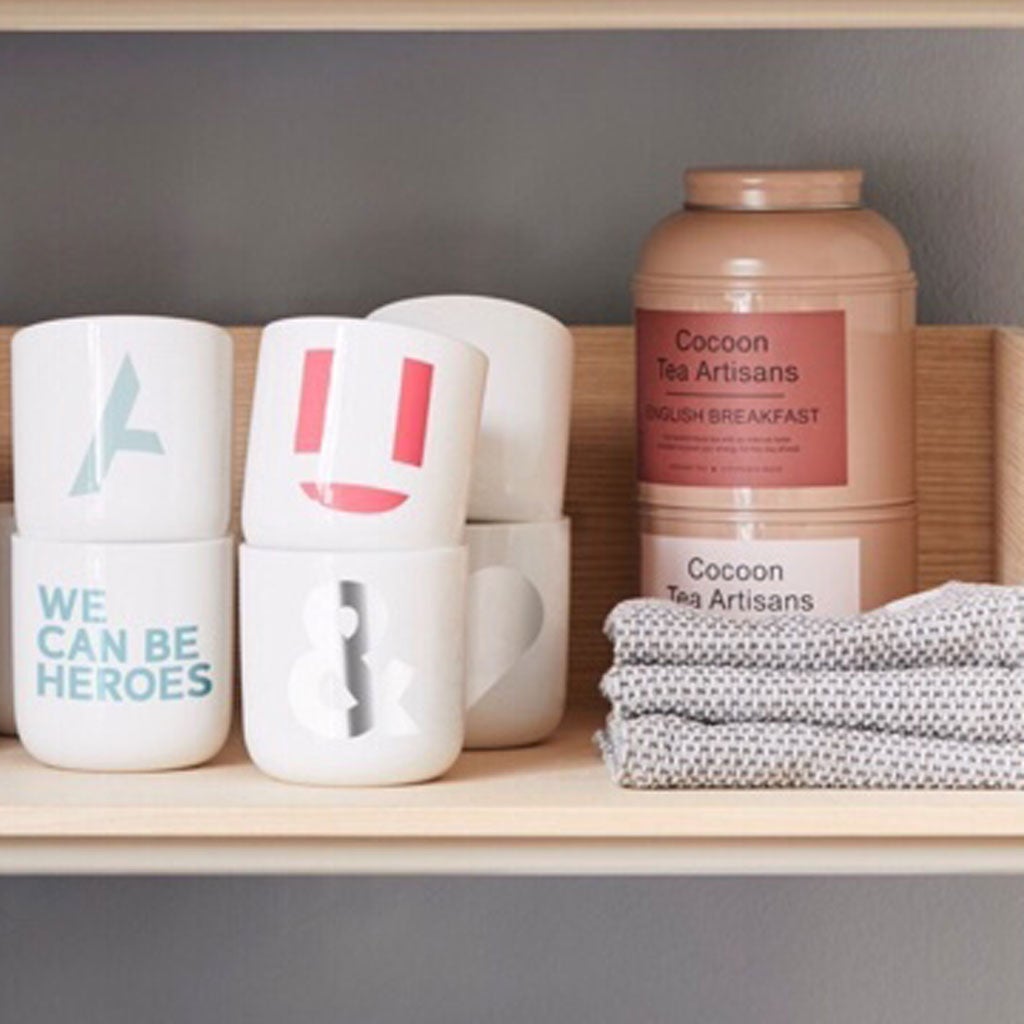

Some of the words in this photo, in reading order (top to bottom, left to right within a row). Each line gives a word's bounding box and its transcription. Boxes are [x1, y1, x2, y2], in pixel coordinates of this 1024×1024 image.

[675, 329, 769, 353] Cocoon
[656, 357, 689, 382] Tea
[696, 360, 800, 383] Artisans
[708, 408, 819, 425] BREAKFAST
[687, 556, 784, 581] Cocoon
[38, 585, 107, 623] WE
[666, 584, 702, 610] Tea
[708, 588, 815, 612] Artisans
[37, 628, 126, 664] CAN
[144, 626, 201, 662] BE
[36, 663, 213, 702] HEROES
